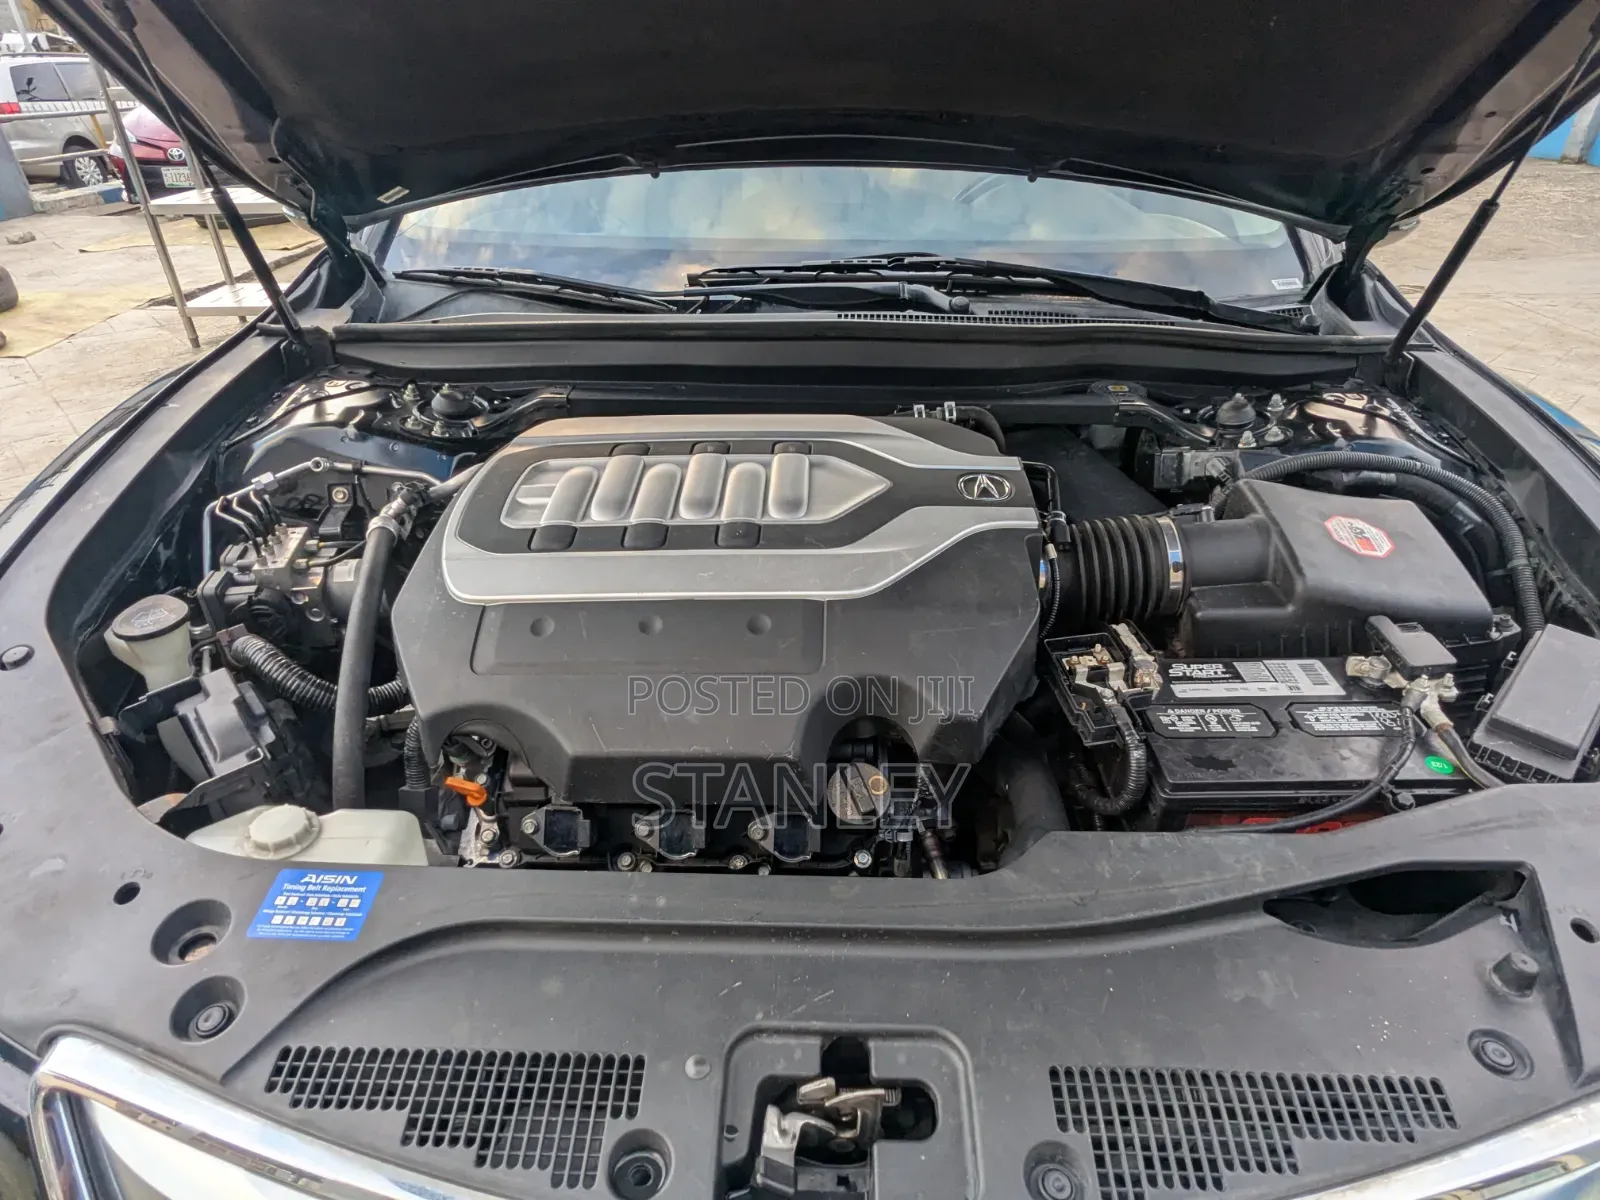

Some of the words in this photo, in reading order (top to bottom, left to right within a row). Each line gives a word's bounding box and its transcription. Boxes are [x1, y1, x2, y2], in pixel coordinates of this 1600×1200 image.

[1168, 669, 1226, 677] START
[300, 873, 358, 885] AISIN
[283, 883, 307, 892] Timing
[307, 883, 321, 892] Belt
[322, 884, 367, 893] Replacement
